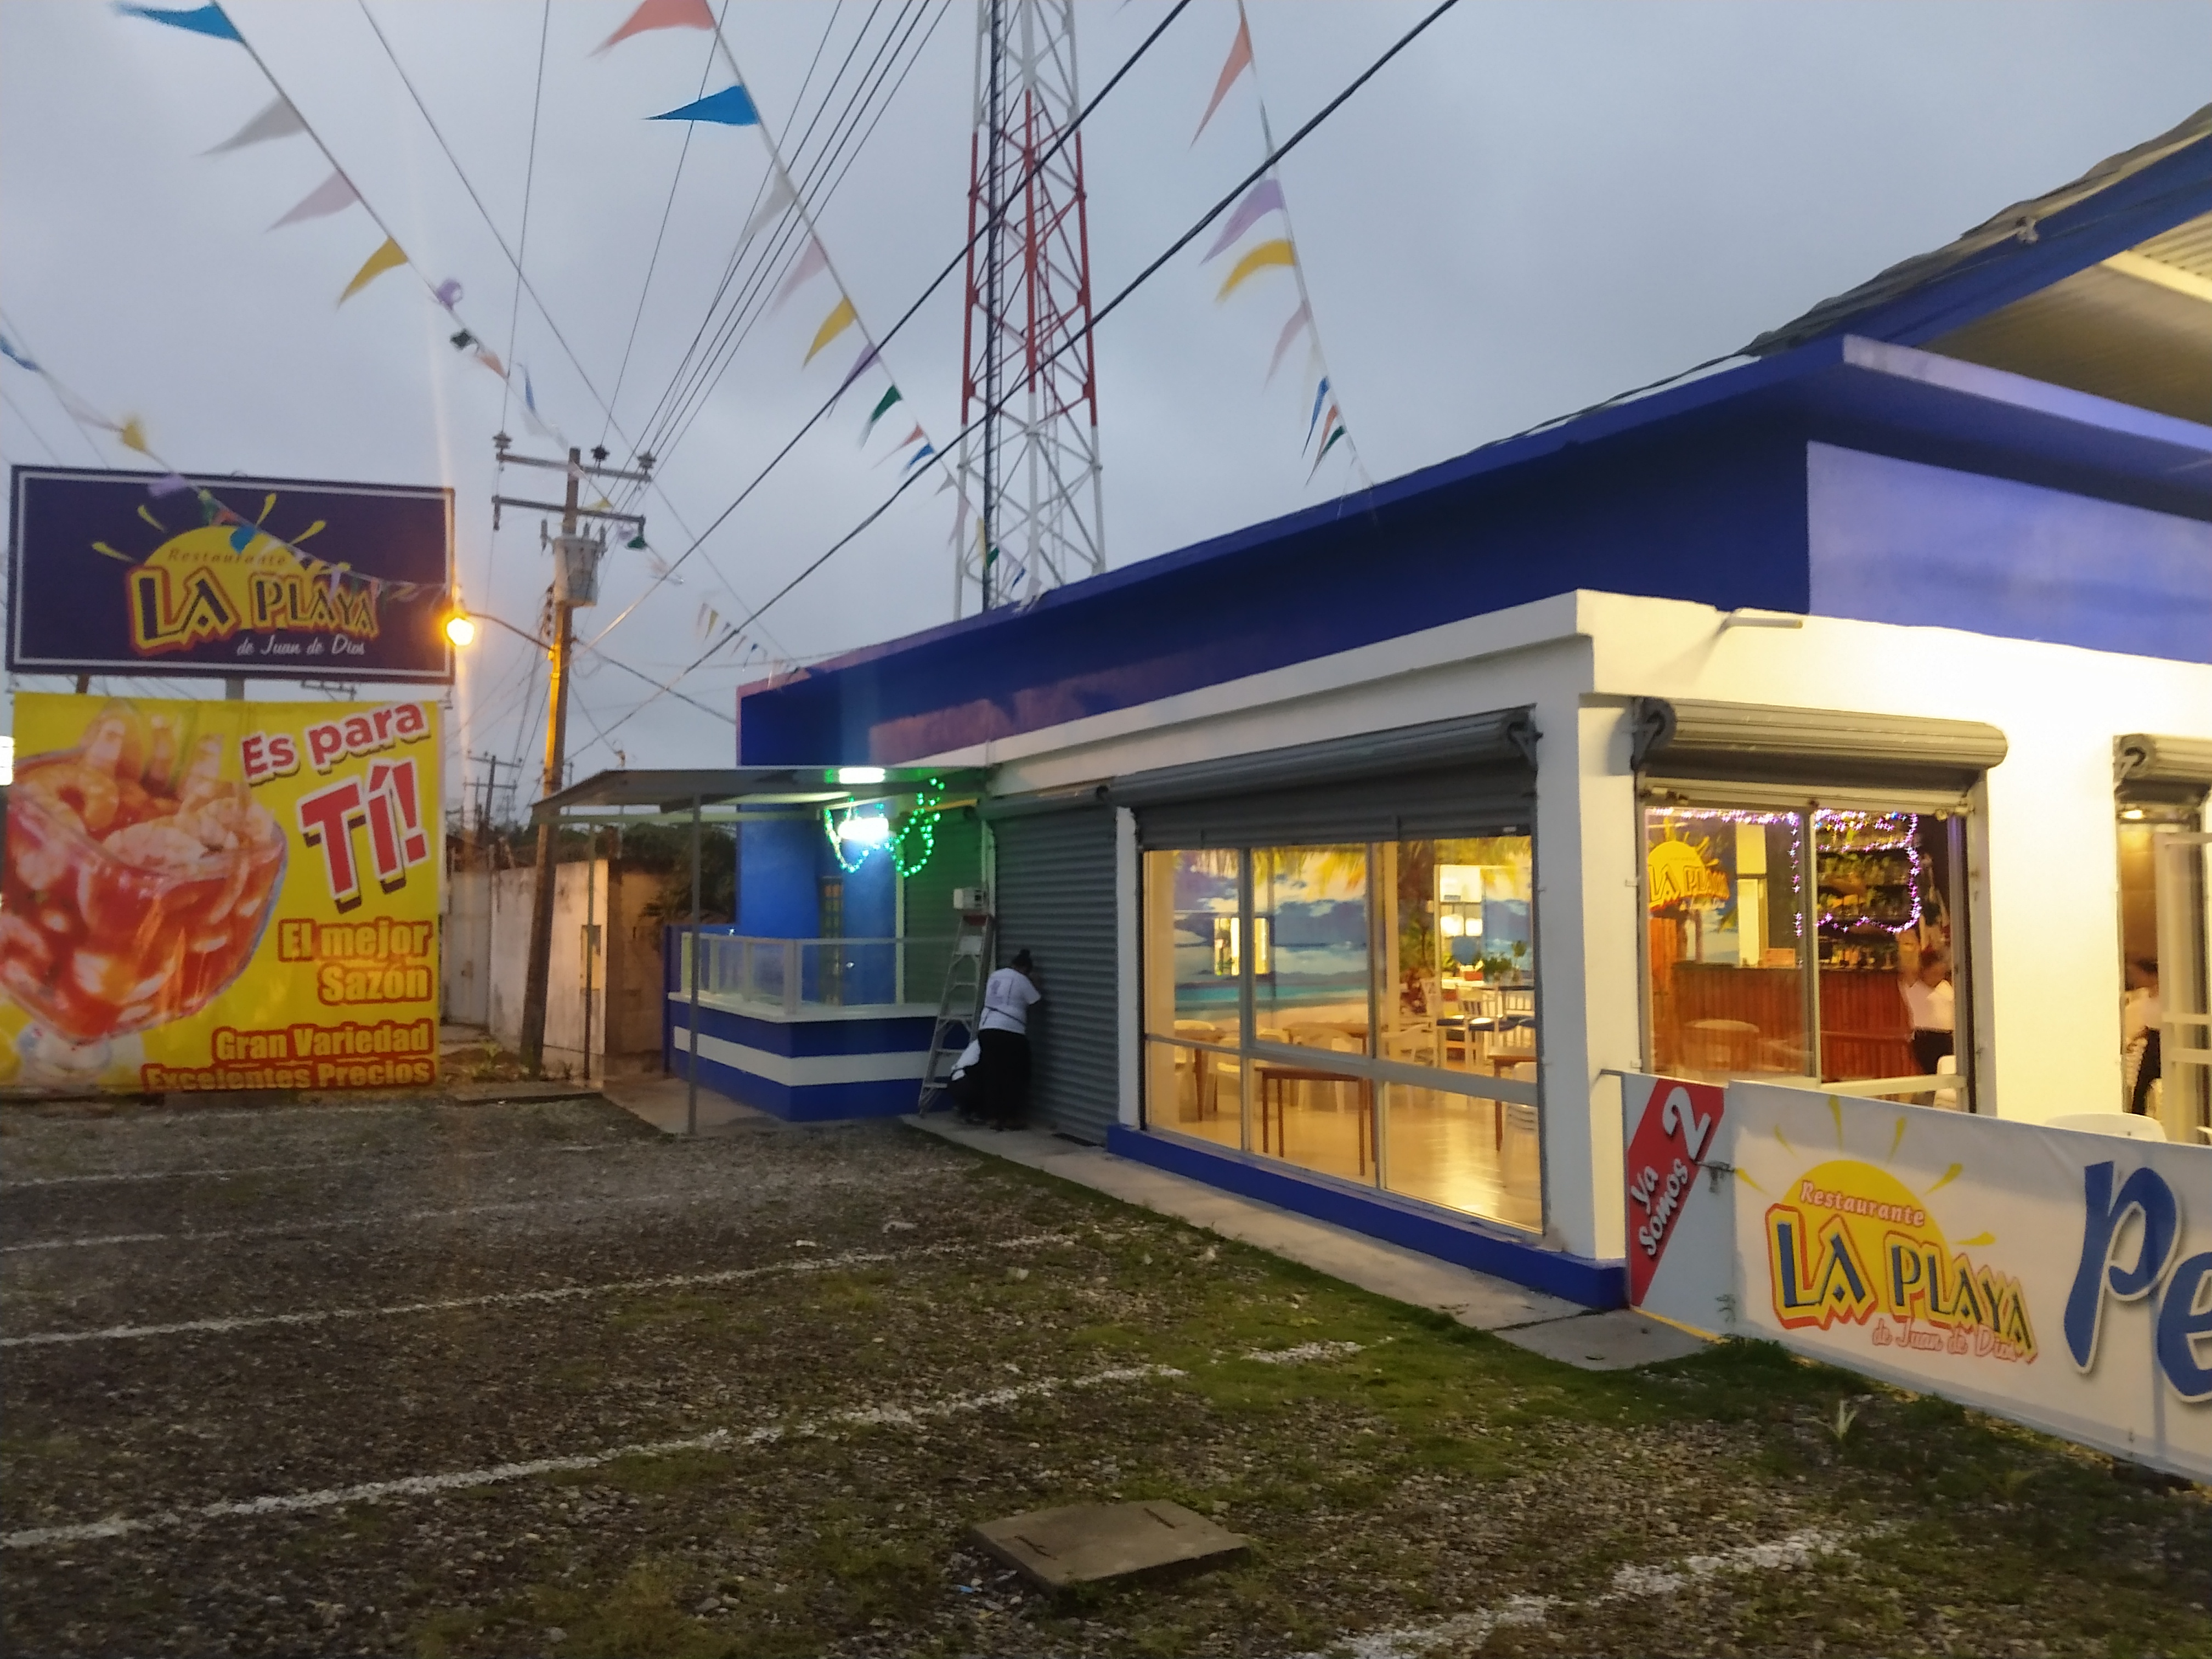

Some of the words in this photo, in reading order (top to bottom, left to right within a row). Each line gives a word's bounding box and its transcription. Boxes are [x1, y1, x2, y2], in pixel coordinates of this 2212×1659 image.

[166, 548, 288, 567] Restaurante
[131, 568, 237, 651] LA
[252, 574, 377, 636] PLAYA
[236, 637, 255, 655] de
[260, 635, 300, 655] Juan
[306, 637, 325, 655] de
[331, 634, 365, 655] Dios
[241, 732, 298, 781] Es
[304, 702, 427, 770] para
[280, 921, 313, 959] El
[320, 919, 431, 960] mejor
[319, 963, 430, 1003] Sazón
[215, 1030, 289, 1061] Gran
[292, 1023, 430, 1058] Variedad
[145, 1065, 312, 1090] Excelentes
[317, 1060, 432, 1088] Precios
[1630, 1165, 1658, 1216] Ya
[1662, 1086, 1711, 1161] 2
[1800, 1180, 1925, 1227] Restaurante
[1769, 1208, 1874, 1323] LA
[1886, 1235, 2036, 1358] PLAYA
[1872, 1318, 1892, 1346] de
[1897, 1319, 1943, 1351] Juan
[1948, 1327, 1968, 1355] de
